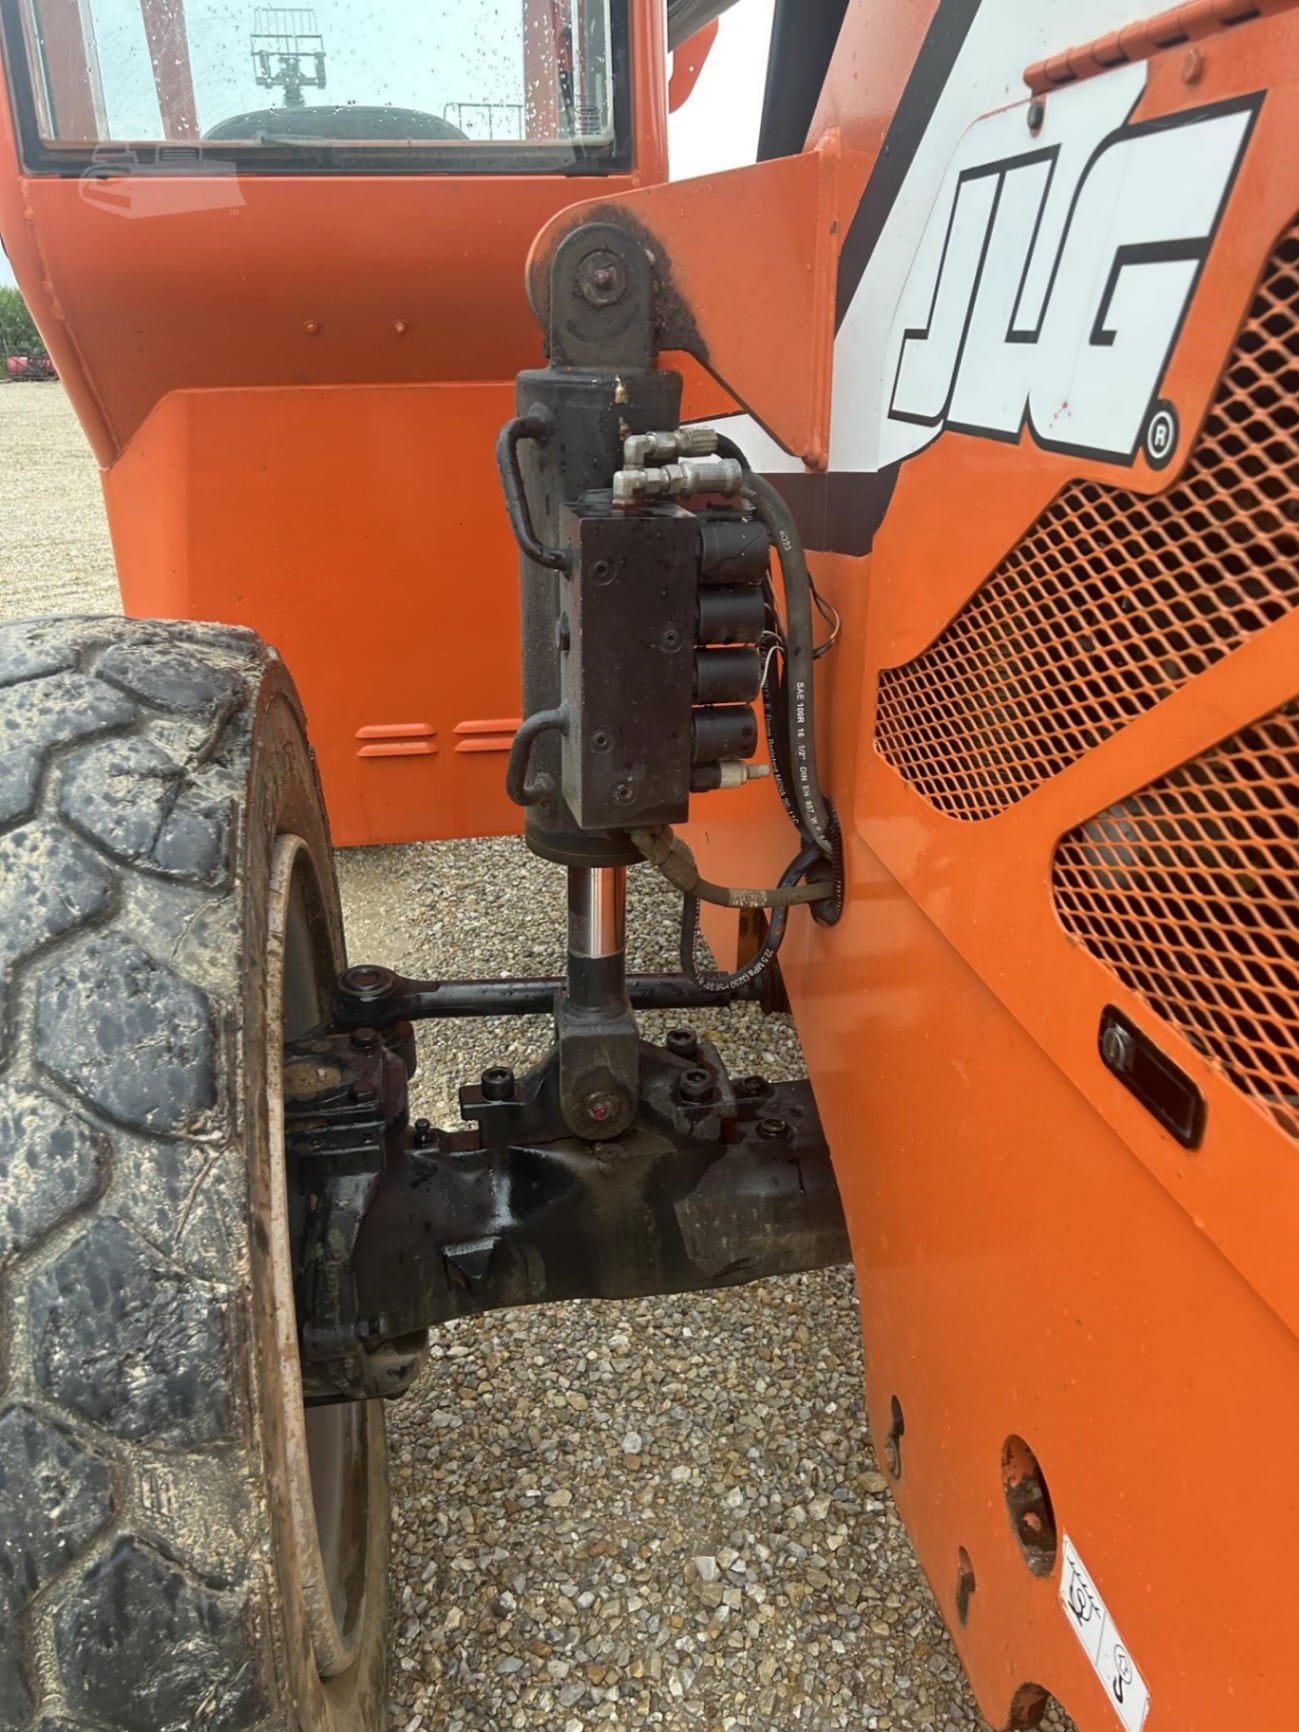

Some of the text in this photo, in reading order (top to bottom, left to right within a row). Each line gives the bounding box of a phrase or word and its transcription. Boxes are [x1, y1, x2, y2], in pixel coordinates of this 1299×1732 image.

[888, 90, 1266, 467] JLG
[796, 681, 805, 700] SAE
[799, 766, 809, 782] DIN
